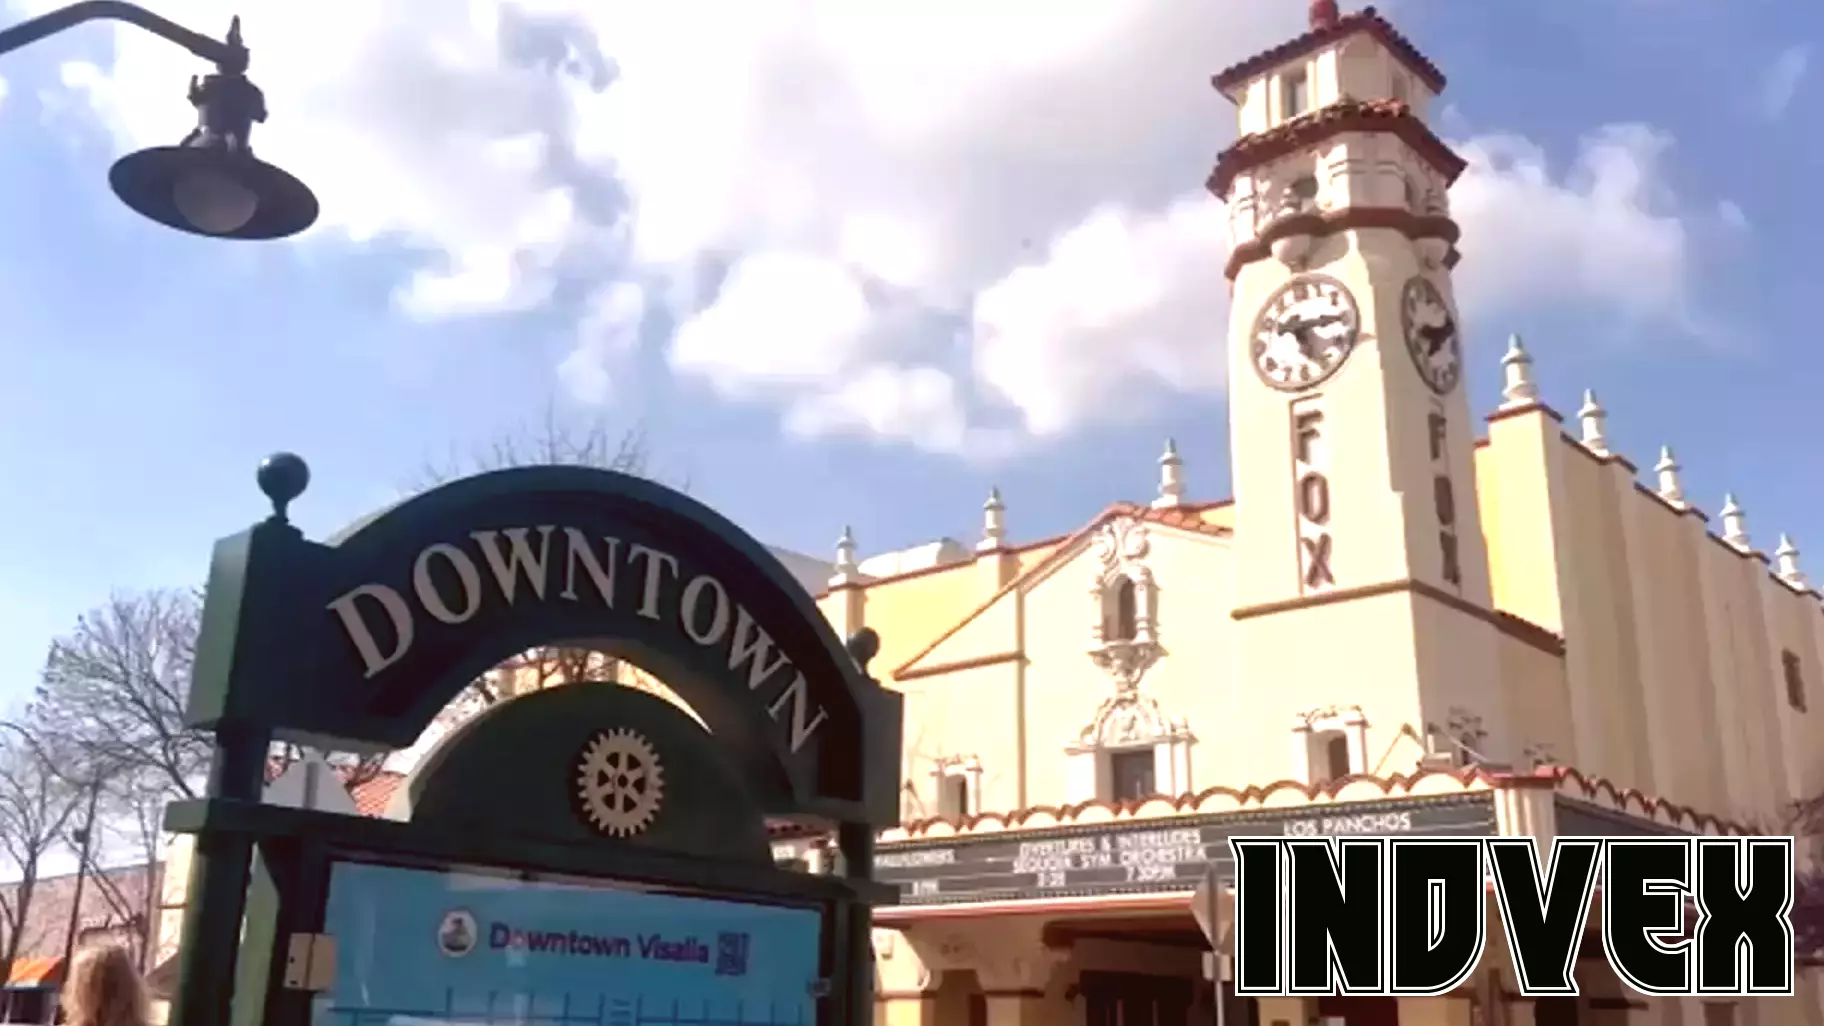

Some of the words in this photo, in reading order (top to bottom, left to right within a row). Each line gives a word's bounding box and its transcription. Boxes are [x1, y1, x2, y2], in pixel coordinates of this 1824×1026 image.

[1295, 408, 1336, 588] FOX
[326, 524, 828, 755] DOWNTOWN
[1283, 818, 1318, 836] LOS
[1322, 812, 1412, 834] PANCHOS
[490, 921, 632, 958] Downtown
[637, 933, 710, 963] Visalia
